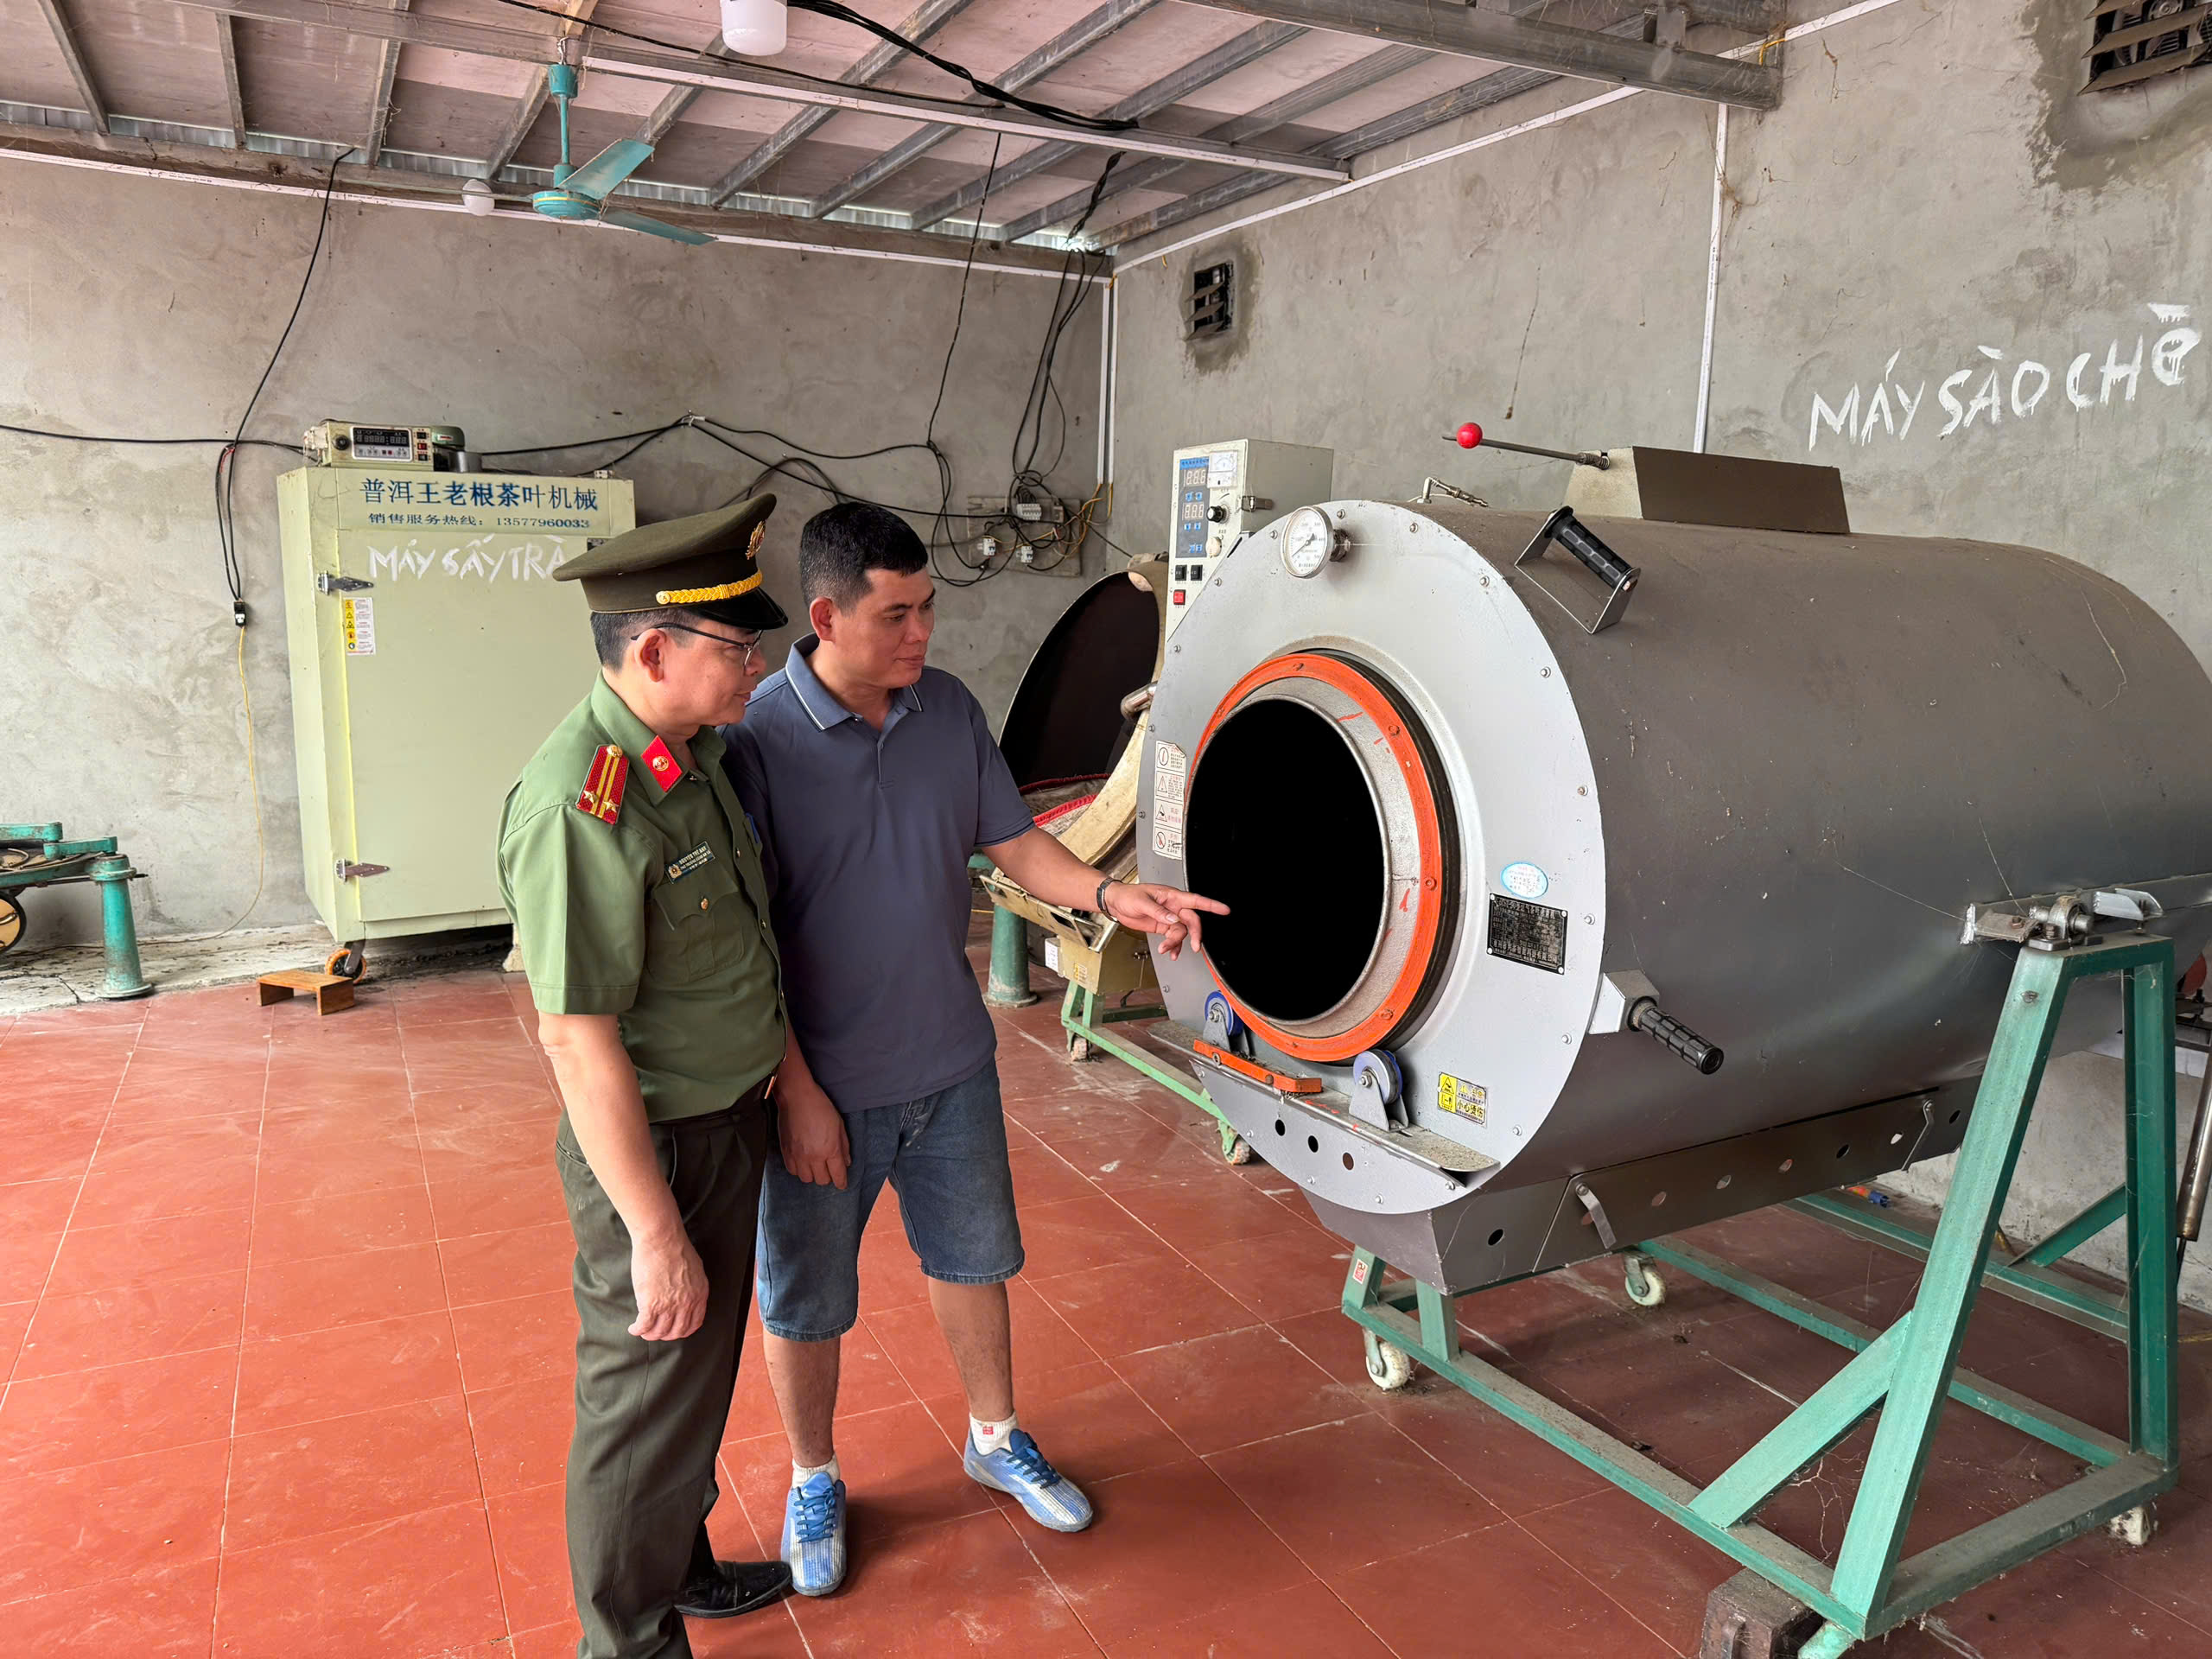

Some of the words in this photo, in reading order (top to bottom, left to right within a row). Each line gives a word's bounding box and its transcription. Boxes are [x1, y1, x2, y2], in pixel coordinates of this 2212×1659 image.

[1808, 347, 1927, 451] MÁY
[1936, 345, 2051, 437] SÀO
[359, 478, 598, 511] 普洱王老根茶叶机械
[366, 538, 436, 582] MÁY
